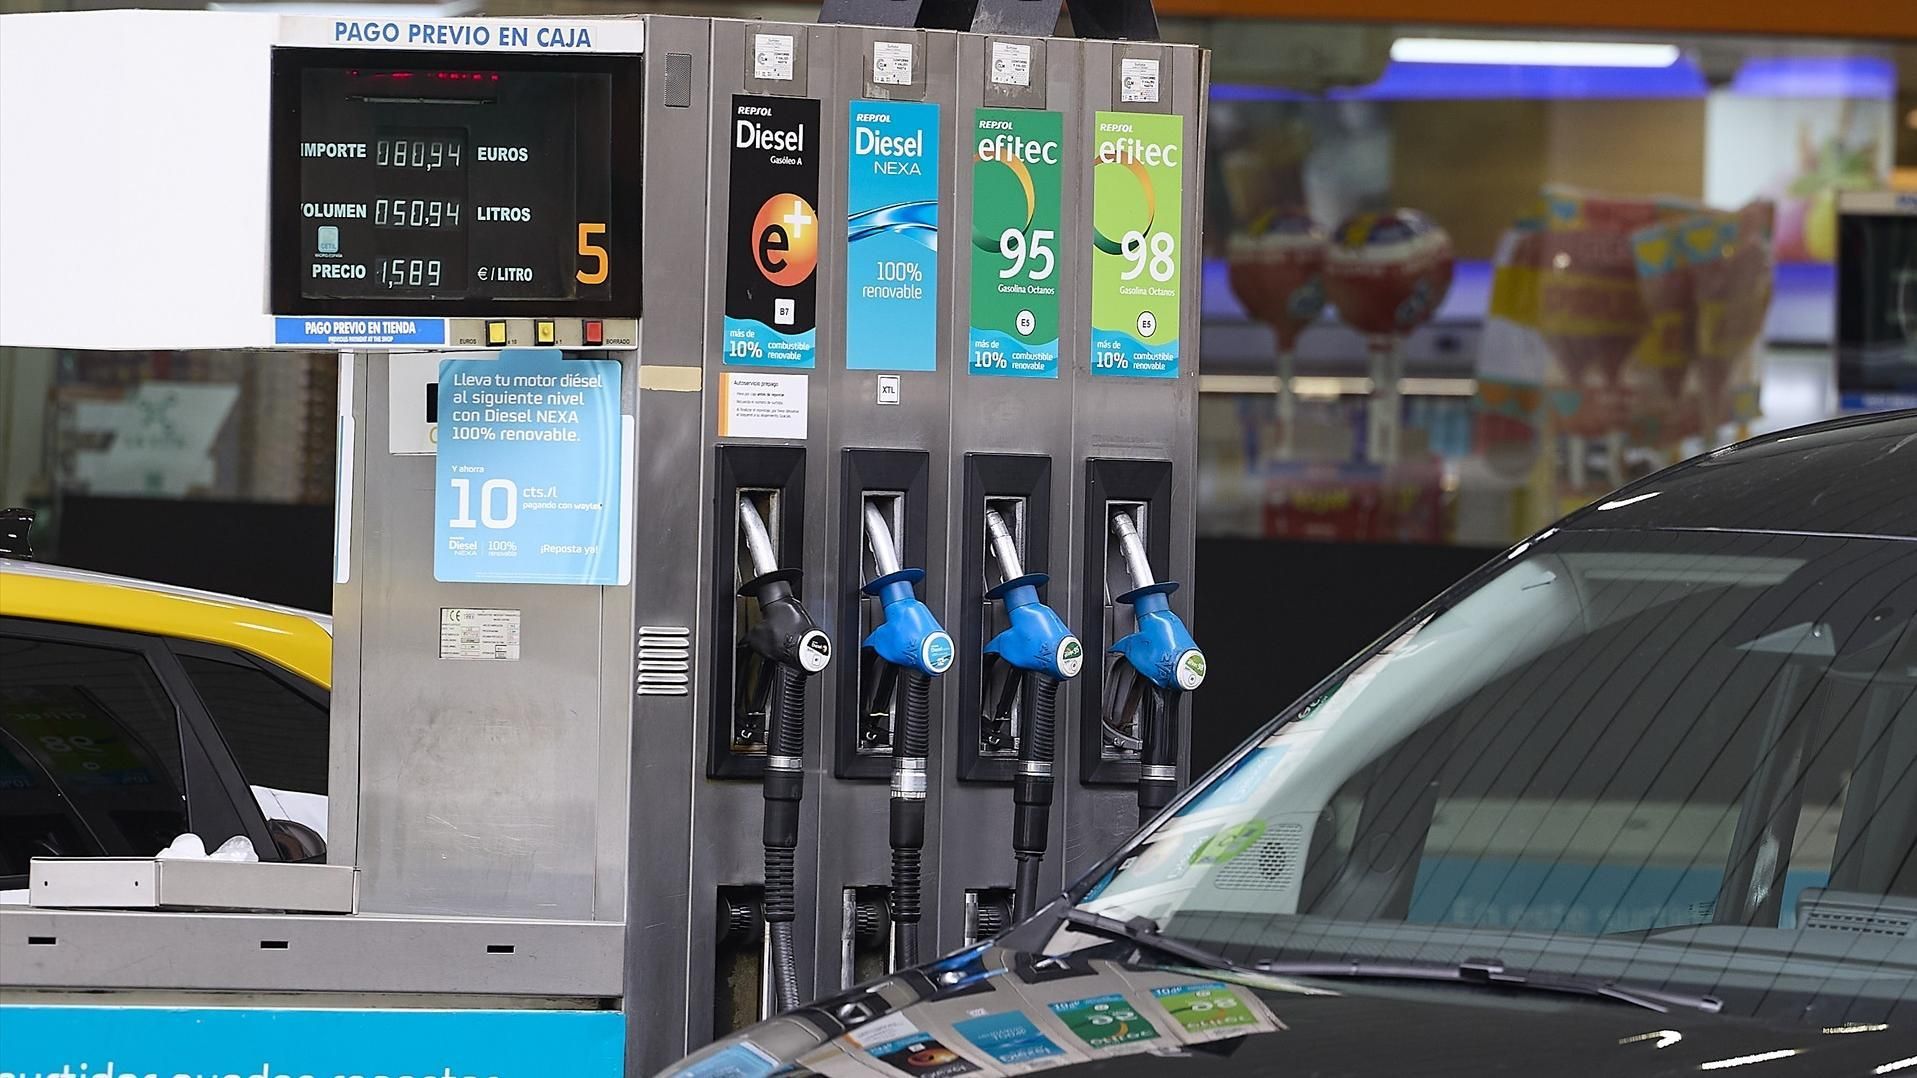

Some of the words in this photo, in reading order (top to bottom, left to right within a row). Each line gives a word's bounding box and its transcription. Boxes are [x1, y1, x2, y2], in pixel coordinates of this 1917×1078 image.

[335, 21, 400, 42] PAGO
[409, 24, 490, 46] PREVIO
[499, 27, 528, 47] EN
[537, 27, 592, 48] CAJA
[737, 106, 773, 117] REPSOL
[856, 113, 891, 123] REPSOL
[979, 120, 1014, 130] REPSOL
[1100, 123, 1134, 133] REPSOL
[736, 120, 804, 152] Diesel
[855, 126, 923, 158] Diesel
[301, 143, 367, 158] IMPORTE
[477, 147, 529, 162] EUROS
[978, 134, 1058, 165] efitec
[1099, 138, 1178, 168] efitec
[770, 155, 796, 165] Gasóleo
[797, 157, 803, 165] A
[874, 161, 922, 176] NEXA
[477, 207, 531, 222] LITROS
[576, 223, 609, 285] 5
[999, 228, 1055, 281] 95
[1120, 230, 1176, 282] 98
[312, 264, 367, 279] PRECIO
[877, 261, 923, 282] 100%
[862, 284, 923, 300] renovable
[998, 283, 1027, 294] Gasolina
[1028, 285, 1056, 296] Octanos
[1119, 285, 1149, 297] Gasolina
[1149, 287, 1176, 297] Octanos
[779, 307, 790, 316] B7
[305, 321, 332, 335] PAGO
[333, 321, 366, 335] PREVIO
[368, 322, 381, 335] EN
[382, 321, 416, 335] TIENDA
[1020, 318, 1031, 328] E5
[1142, 320, 1152, 329] E5
[730, 328, 745, 338] más
[746, 329, 756, 339] de
[730, 340, 763, 359] 10%
[768, 340, 810, 352] combustible
[975, 340, 990, 349] más
[991, 340, 1000, 349] de
[1097, 340, 1111, 350] más
[1112, 340, 1121, 350] de
[767, 350, 802, 360] renovable
[974, 350, 1007, 369] 10%
[1012, 351, 1054, 362] combustible
[1096, 351, 1129, 370] 10%
[1133, 351, 1174, 362] combustible
[1012, 361, 1045, 371] renovable
[1133, 361, 1166, 371] renovable
[454, 373, 492, 387] Lleva
[495, 374, 511, 387] tu
[513, 374, 557, 388] motor
[560, 373, 603, 388] diésel
[881, 385, 896, 395] XTL
[453, 390, 468, 404] al
[472, 391, 543, 408] siguiente
[547, 391, 585, 406] nivel
[452, 410, 480, 422] con
[484, 408, 532, 423] Diesel
[536, 410, 579, 424] NEXA
[452, 426, 496, 441] 100%
[500, 427, 580, 442] renovable.
[451, 465, 458, 473] Y
[459, 465, 485, 473] ahorra
[449, 478, 518, 529] 10
[522, 502, 557, 511] pagando
[558, 502, 573, 510] con
[449, 540, 478, 550] Diesel
[488, 541, 517, 551] 100%
